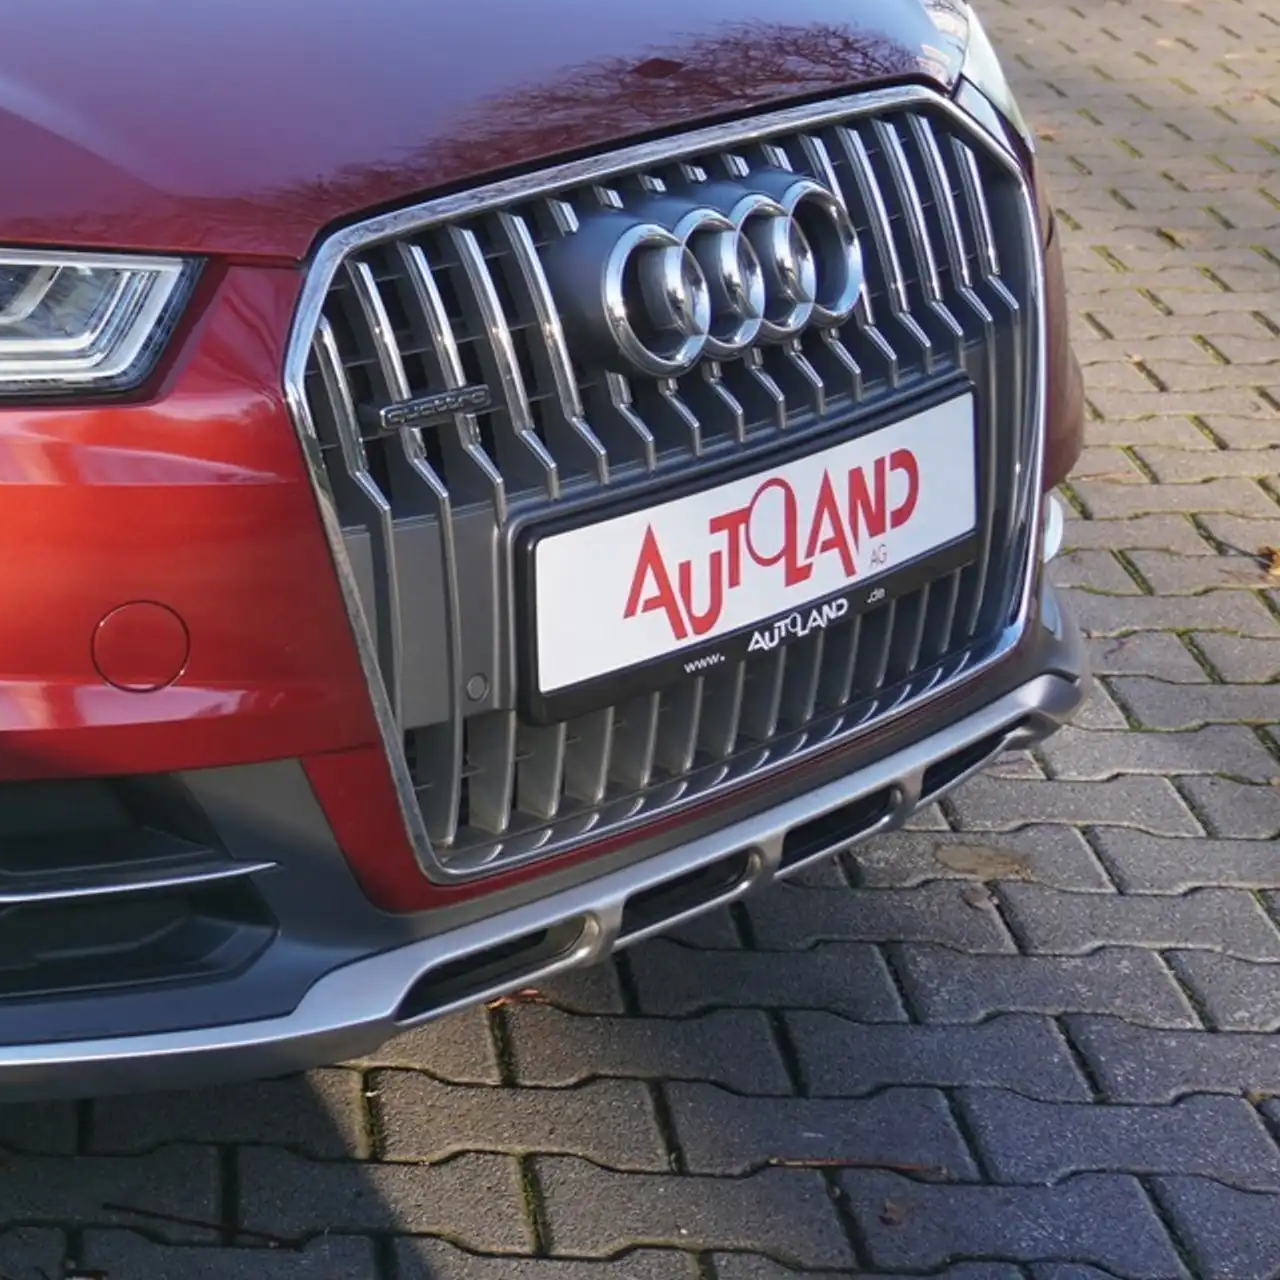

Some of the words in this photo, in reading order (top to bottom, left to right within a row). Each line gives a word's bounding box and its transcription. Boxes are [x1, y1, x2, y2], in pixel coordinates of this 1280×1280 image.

[869, 545, 887, 568] AG
[684, 652, 726, 674] www.
[867, 587, 886, 604] .de
